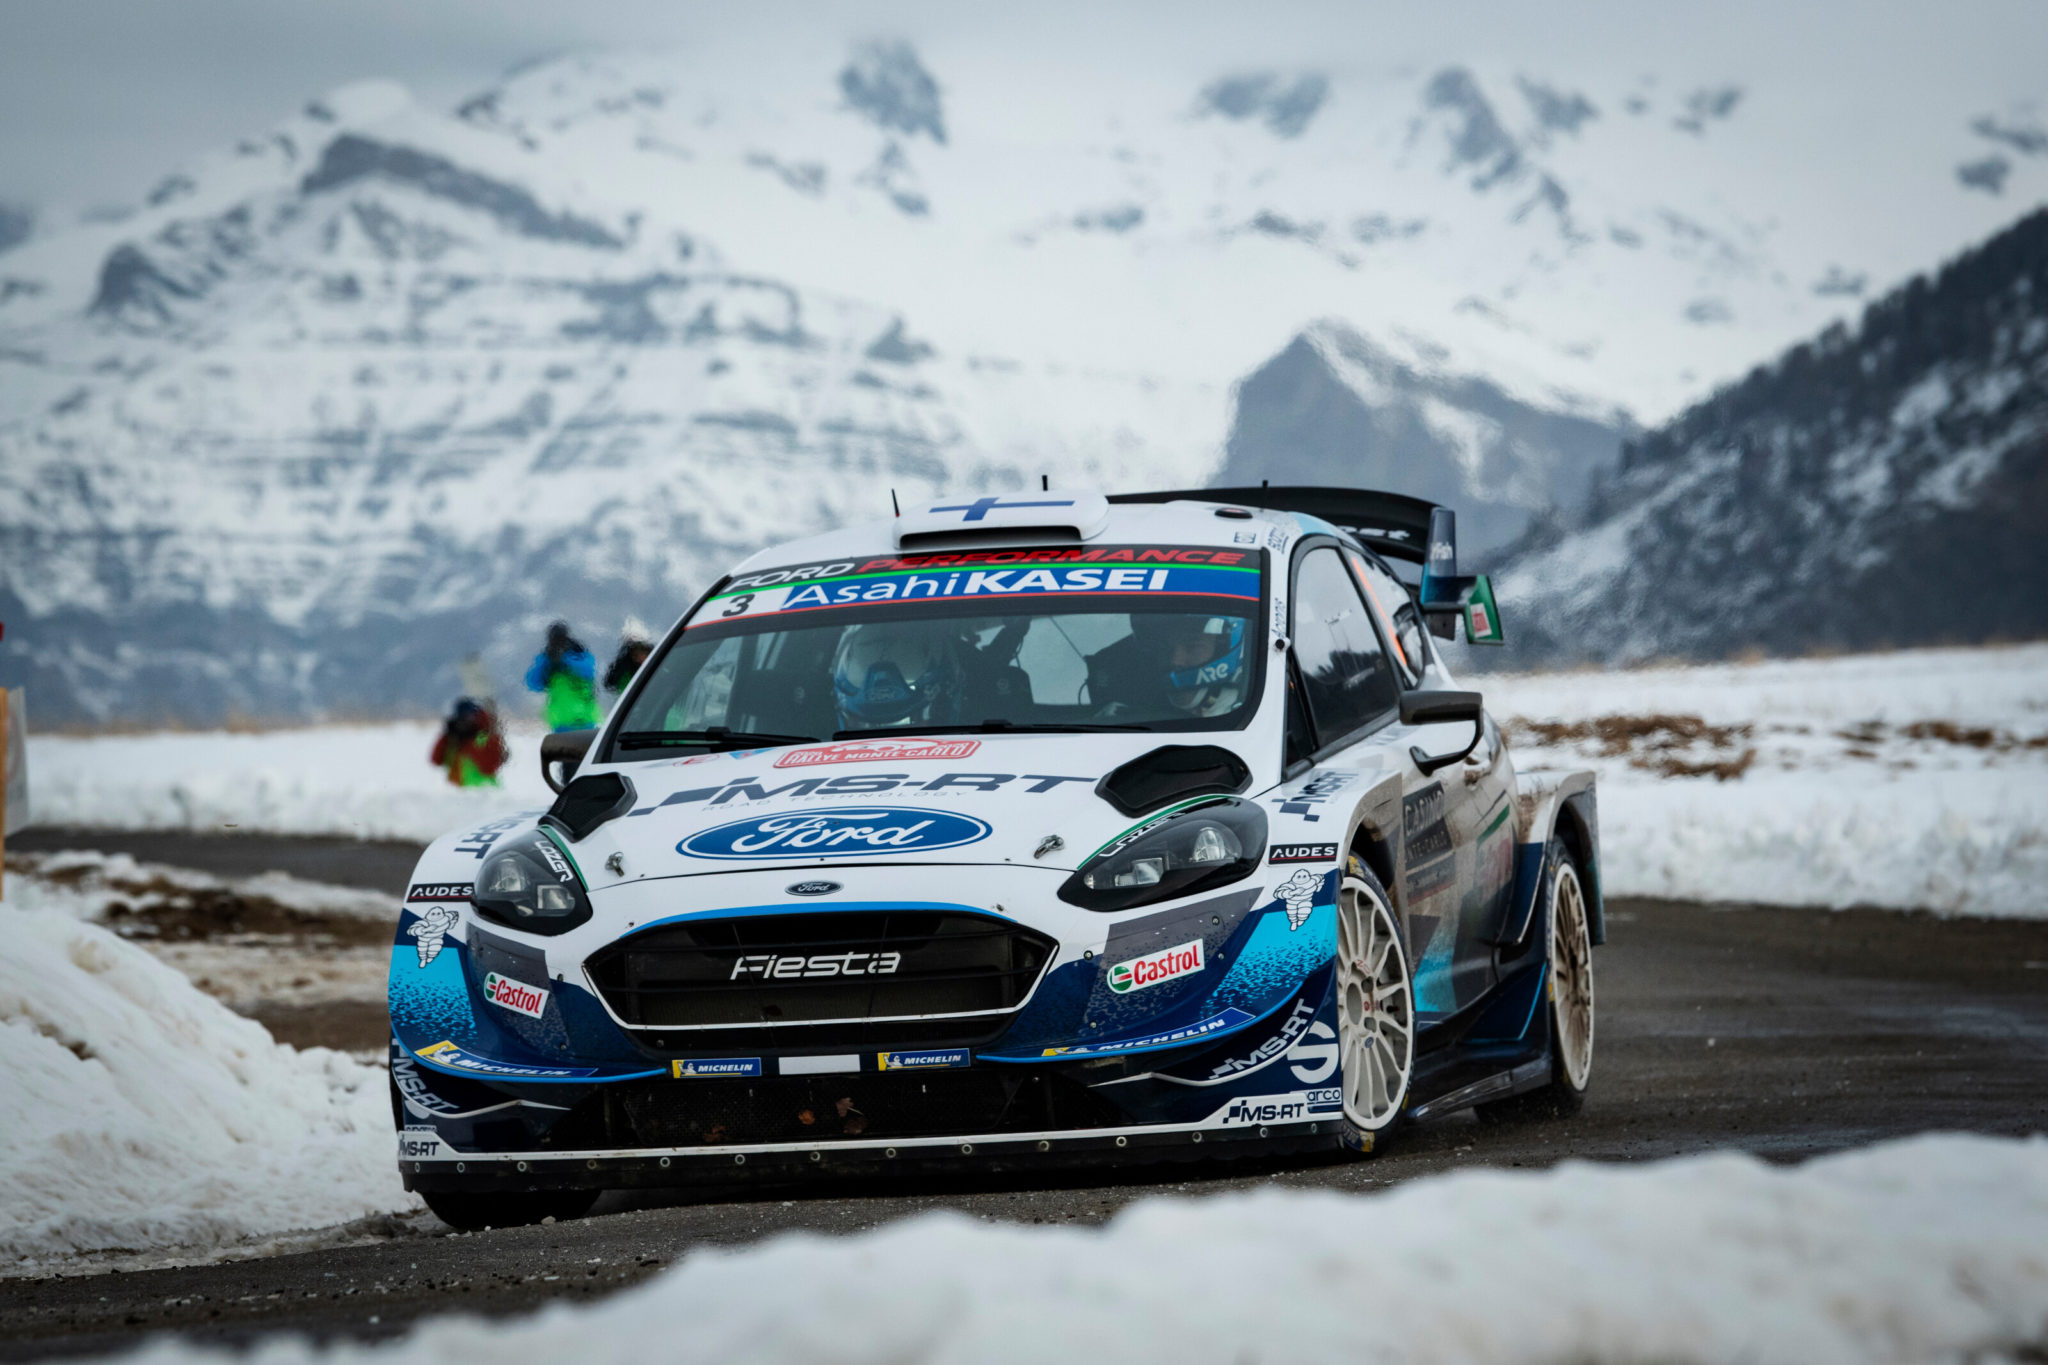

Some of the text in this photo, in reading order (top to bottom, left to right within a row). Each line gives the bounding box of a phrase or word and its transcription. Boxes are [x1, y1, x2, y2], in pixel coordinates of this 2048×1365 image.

[723, 550, 1246, 592] FORD PERFORMANCE
[722, 594, 755, 617] 3
[784, 750, 840, 765] RALLYE
[702, 791, 967, 812] ROAD TECHNOLOGY
[731, 812, 936, 853] Ford
[1270, 846, 1335, 858] AUDES
[411, 886, 474, 897] AUDES
[798, 881, 832, 892] Ford
[730, 951, 901, 980] Fiesta
[1134, 944, 1200, 985] Castrol
[495, 979, 543, 1014] Castrol
[1098, 1018, 1226, 1051] MICHELIN
[1232, 998, 1315, 1071] MS-RT
[454, 1058, 572, 1076] MICHELIN
[697, 1063, 753, 1073] MICHELIN
[904, 1053, 962, 1066] MICHELIN
[393, 1057, 460, 1111] MS-RT
[1307, 1088, 1342, 1102] arco
[1240, 1102, 1305, 1122] MS-RT
